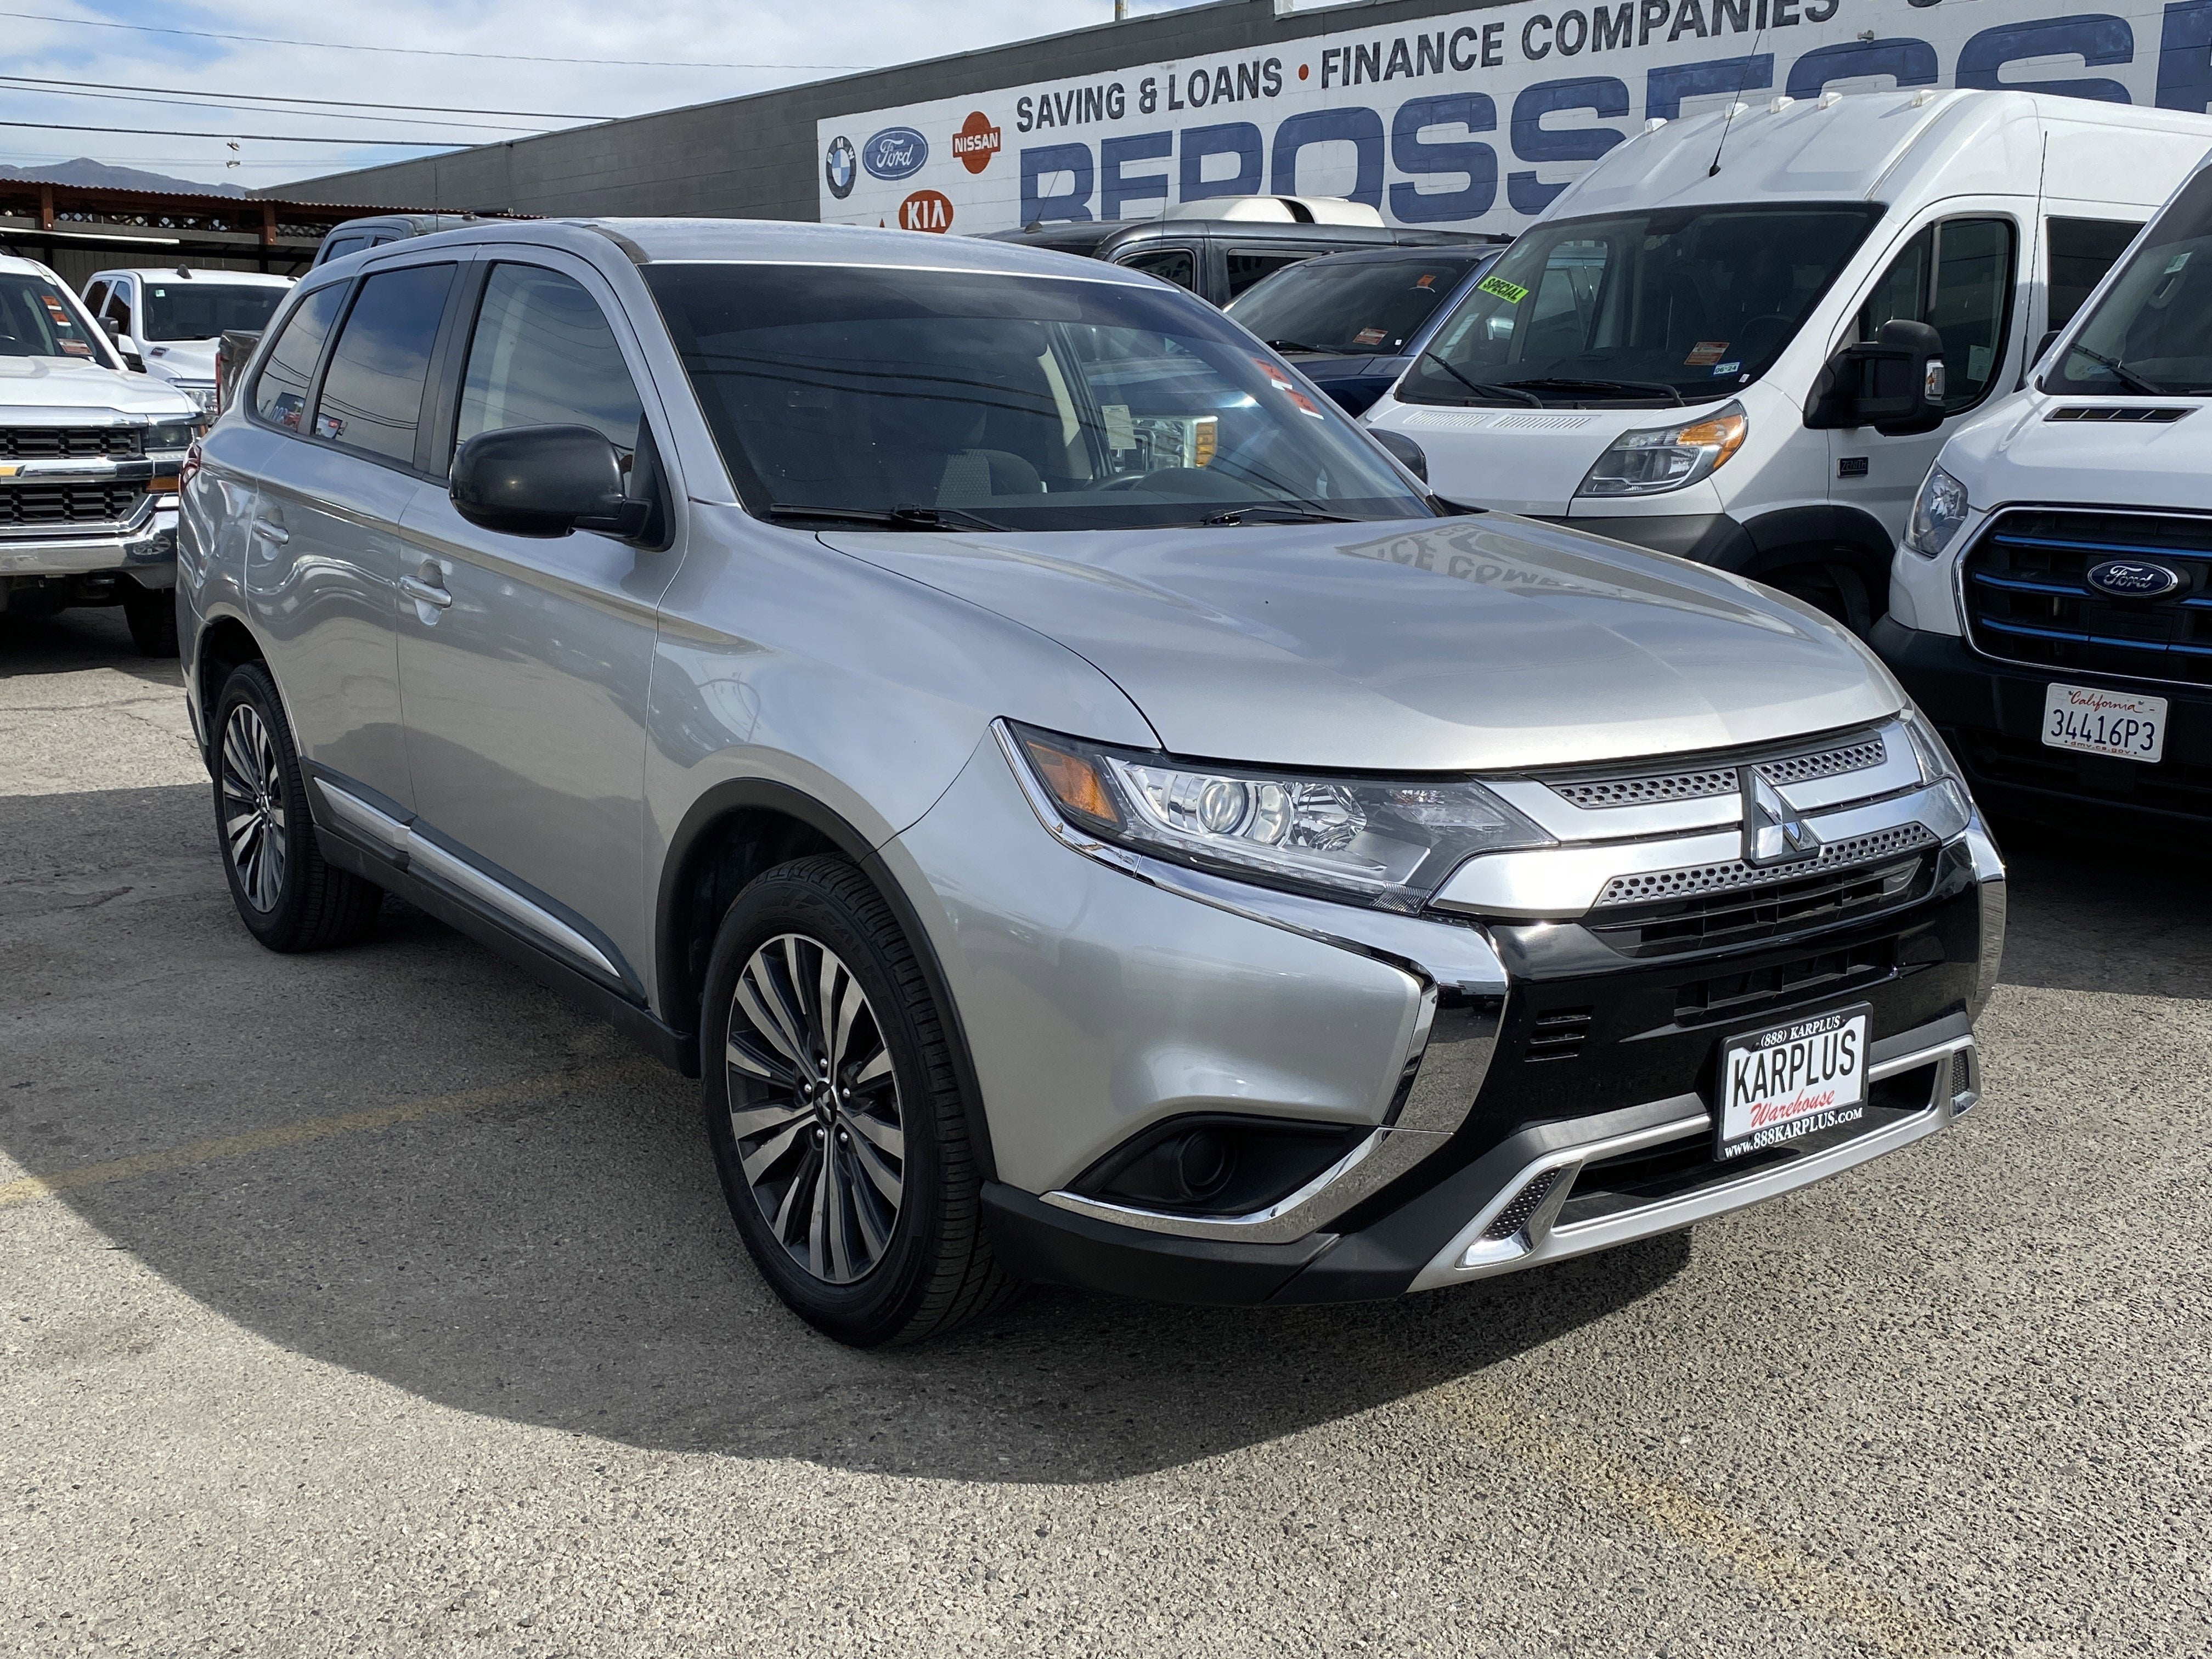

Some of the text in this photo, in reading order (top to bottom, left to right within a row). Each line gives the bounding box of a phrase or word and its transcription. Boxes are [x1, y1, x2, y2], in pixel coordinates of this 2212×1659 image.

[1017, 82, 1125, 132] SAVING
[1139, 77, 1156, 114] &
[1169, 58, 1282, 110] LOANS
[1322, 22, 1504, 89] FINANCE
[877, 139, 913, 168] Ford
[955, 132, 998, 153] NISSAN
[907, 199, 946, 229] KIA
[1483, 278, 1523, 301] SPECIAL
[2103, 566, 2154, 588] Ford
[2070, 691, 2143, 714] California
[2051, 709, 2155, 751] 34416P3
[1760, 1015, 1841, 1047] (888) KARPLUS
[1733, 1029, 1857, 1108] KARPLUS
[1750, 1088, 1835, 1128] Warehouse
